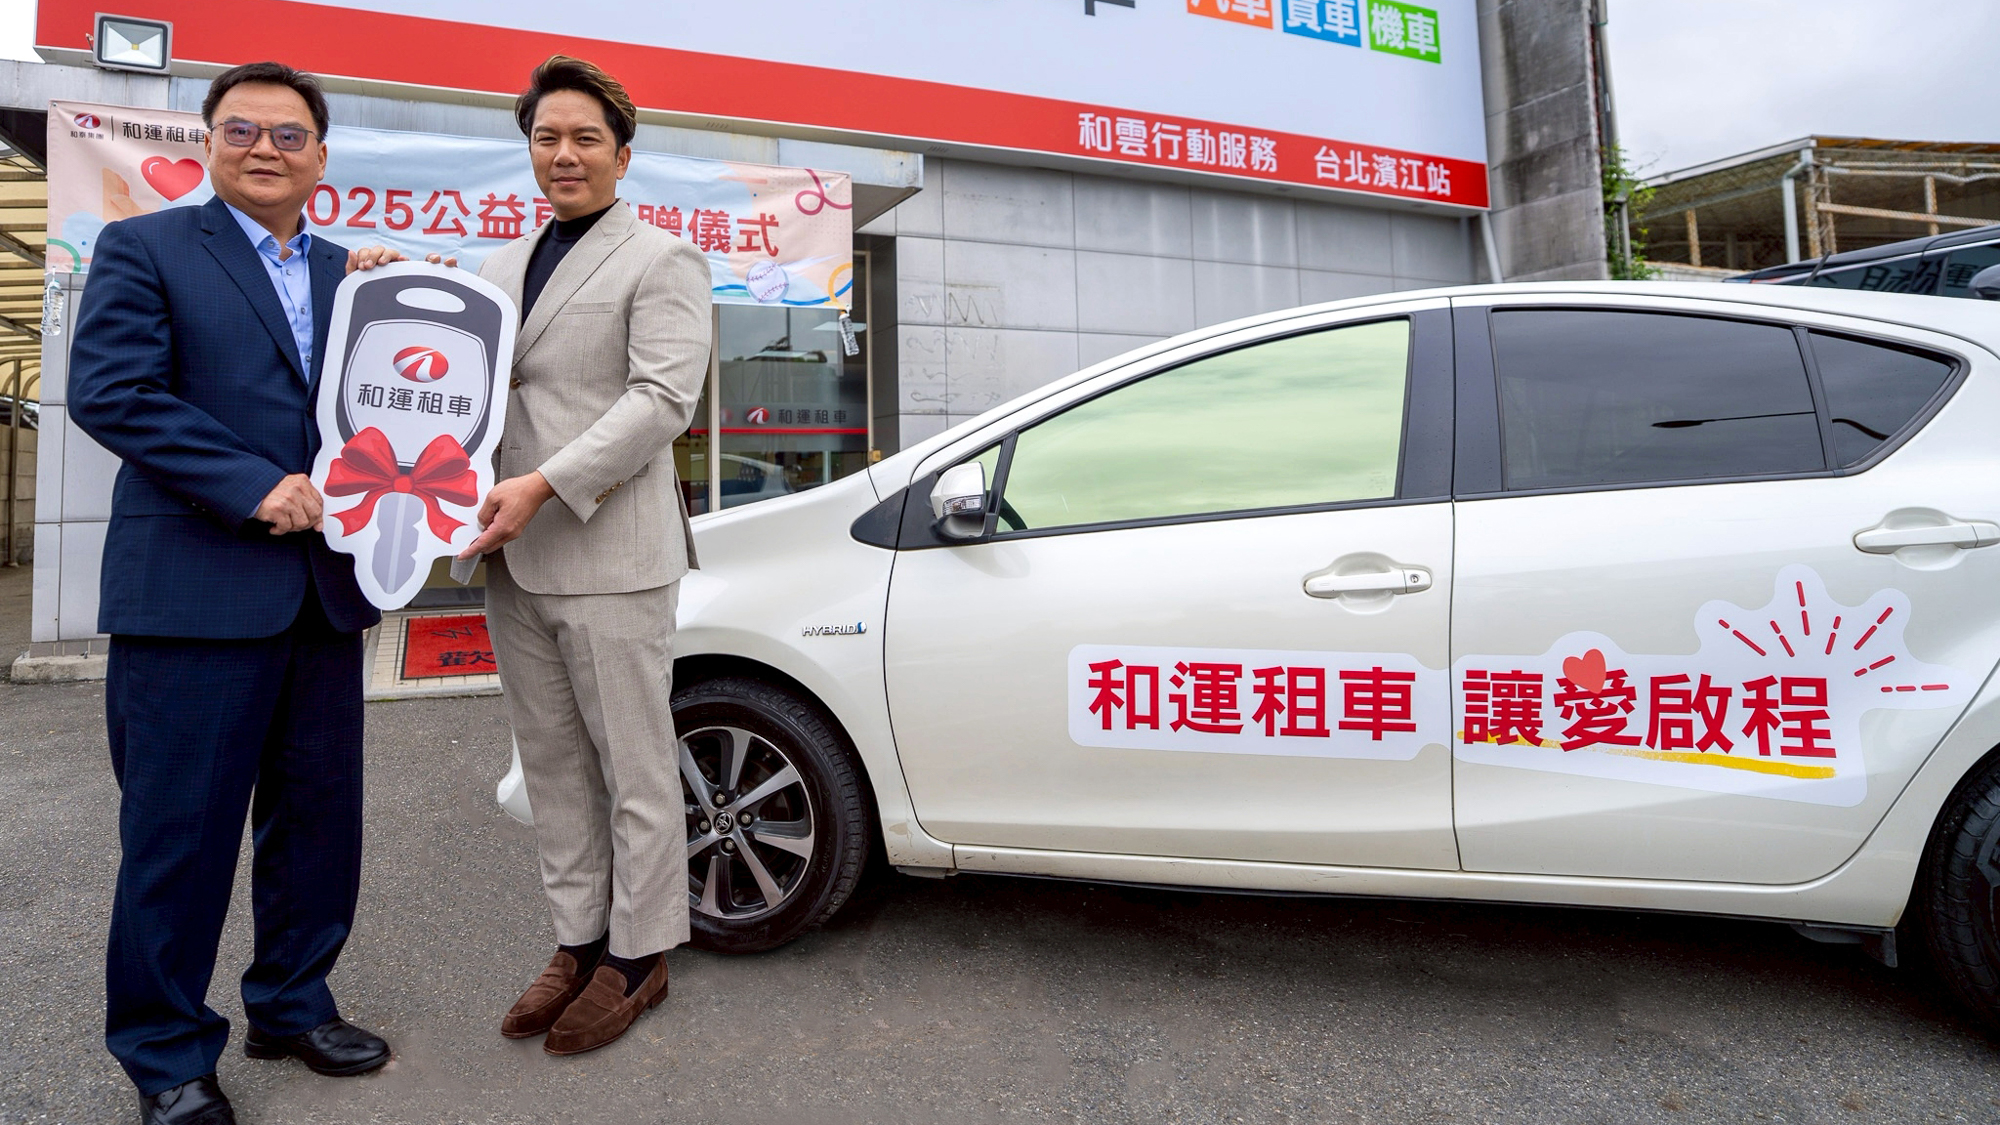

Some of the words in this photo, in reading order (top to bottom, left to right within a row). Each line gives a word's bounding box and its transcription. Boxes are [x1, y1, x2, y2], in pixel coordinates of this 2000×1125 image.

[1371, 3, 1438, 55] 機車
[122, 121, 205, 144] 和運租車
[1078, 112, 1278, 173] 和雲行動服務
[1314, 145, 1451, 196] 台北濱江站
[357, 383, 473, 418] 和運租車
[778, 408, 847, 425] 和運租車
[802, 624, 857, 637] HYBRID
[1088, 659, 1417, 741] 和運租車
[1462, 669, 1837, 759] 讓愛啟程
